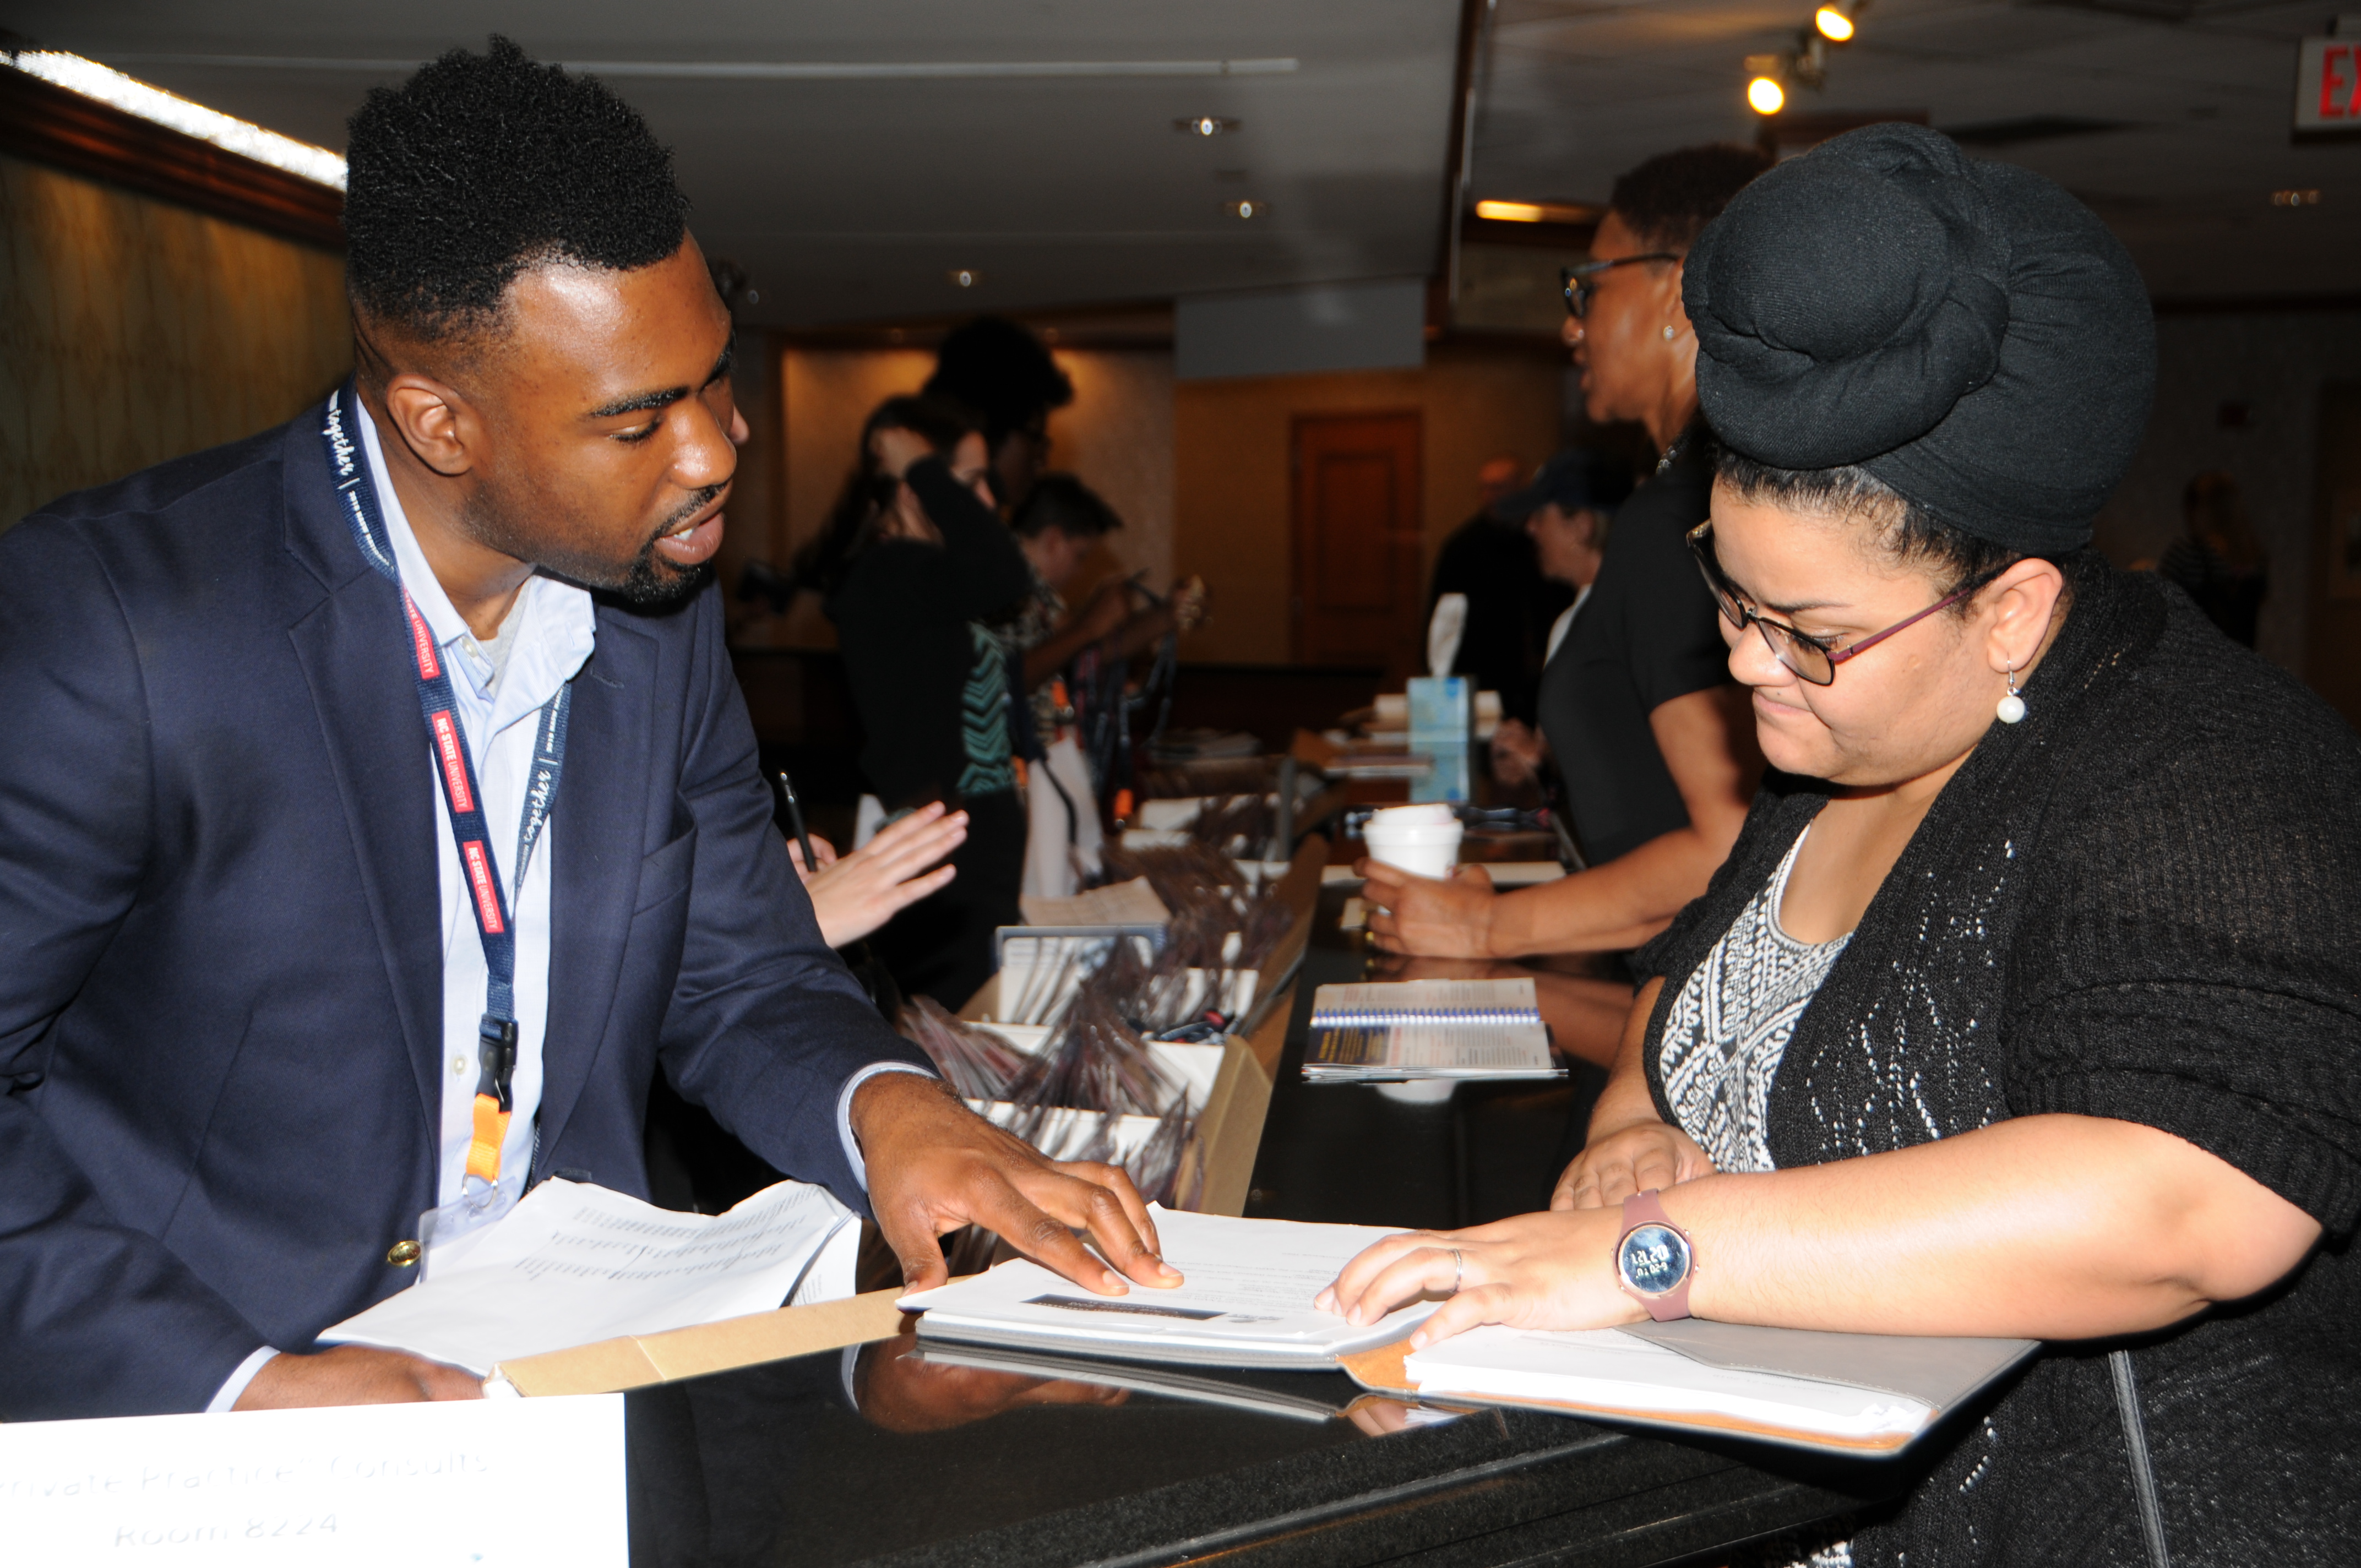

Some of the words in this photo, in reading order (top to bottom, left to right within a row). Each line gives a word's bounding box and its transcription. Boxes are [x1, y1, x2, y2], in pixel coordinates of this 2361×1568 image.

[322, 409, 355, 476] together
[414, 619, 434, 673] UNIVERSITY
[436, 717, 449, 733] NC
[440, 732, 456, 767] STATE
[447, 761, 469, 809] UNIVERSITY
[524, 770, 551, 842] together
[468, 846, 480, 862] NC
[471, 860, 487, 886] STATE
[477, 881, 498, 929] UNIVERSITY
[330, 1450, 488, 1479] Consults
[114, 1525, 228, 1547] Room
[244, 1513, 338, 1538] 8224
